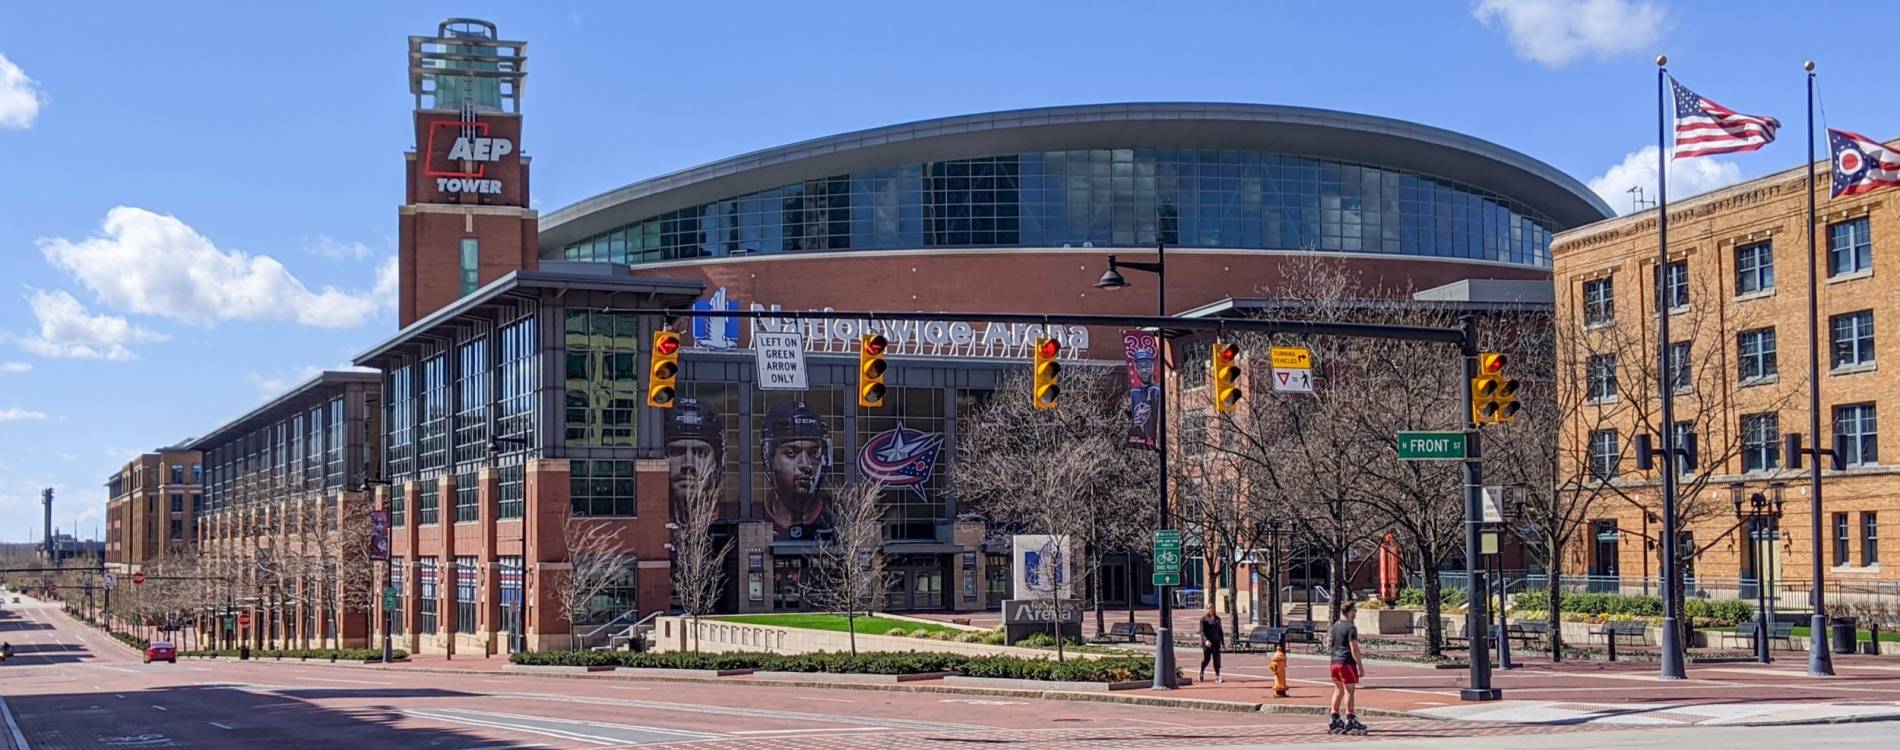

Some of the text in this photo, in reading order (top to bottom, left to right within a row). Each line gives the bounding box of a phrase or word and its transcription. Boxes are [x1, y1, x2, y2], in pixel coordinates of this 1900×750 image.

[448, 137, 512, 161] AEP
[437, 178, 502, 194] TOWER
[981, 319, 1089, 349] Arena
[760, 337, 797, 347] LEFT ON
[1124, 335, 1158, 360] 38
[766, 350, 795, 359] GREEN
[766, 362, 797, 371] ARROW
[771, 374, 795, 384] ONLY
[1410, 439, 1449, 452] FRONT
